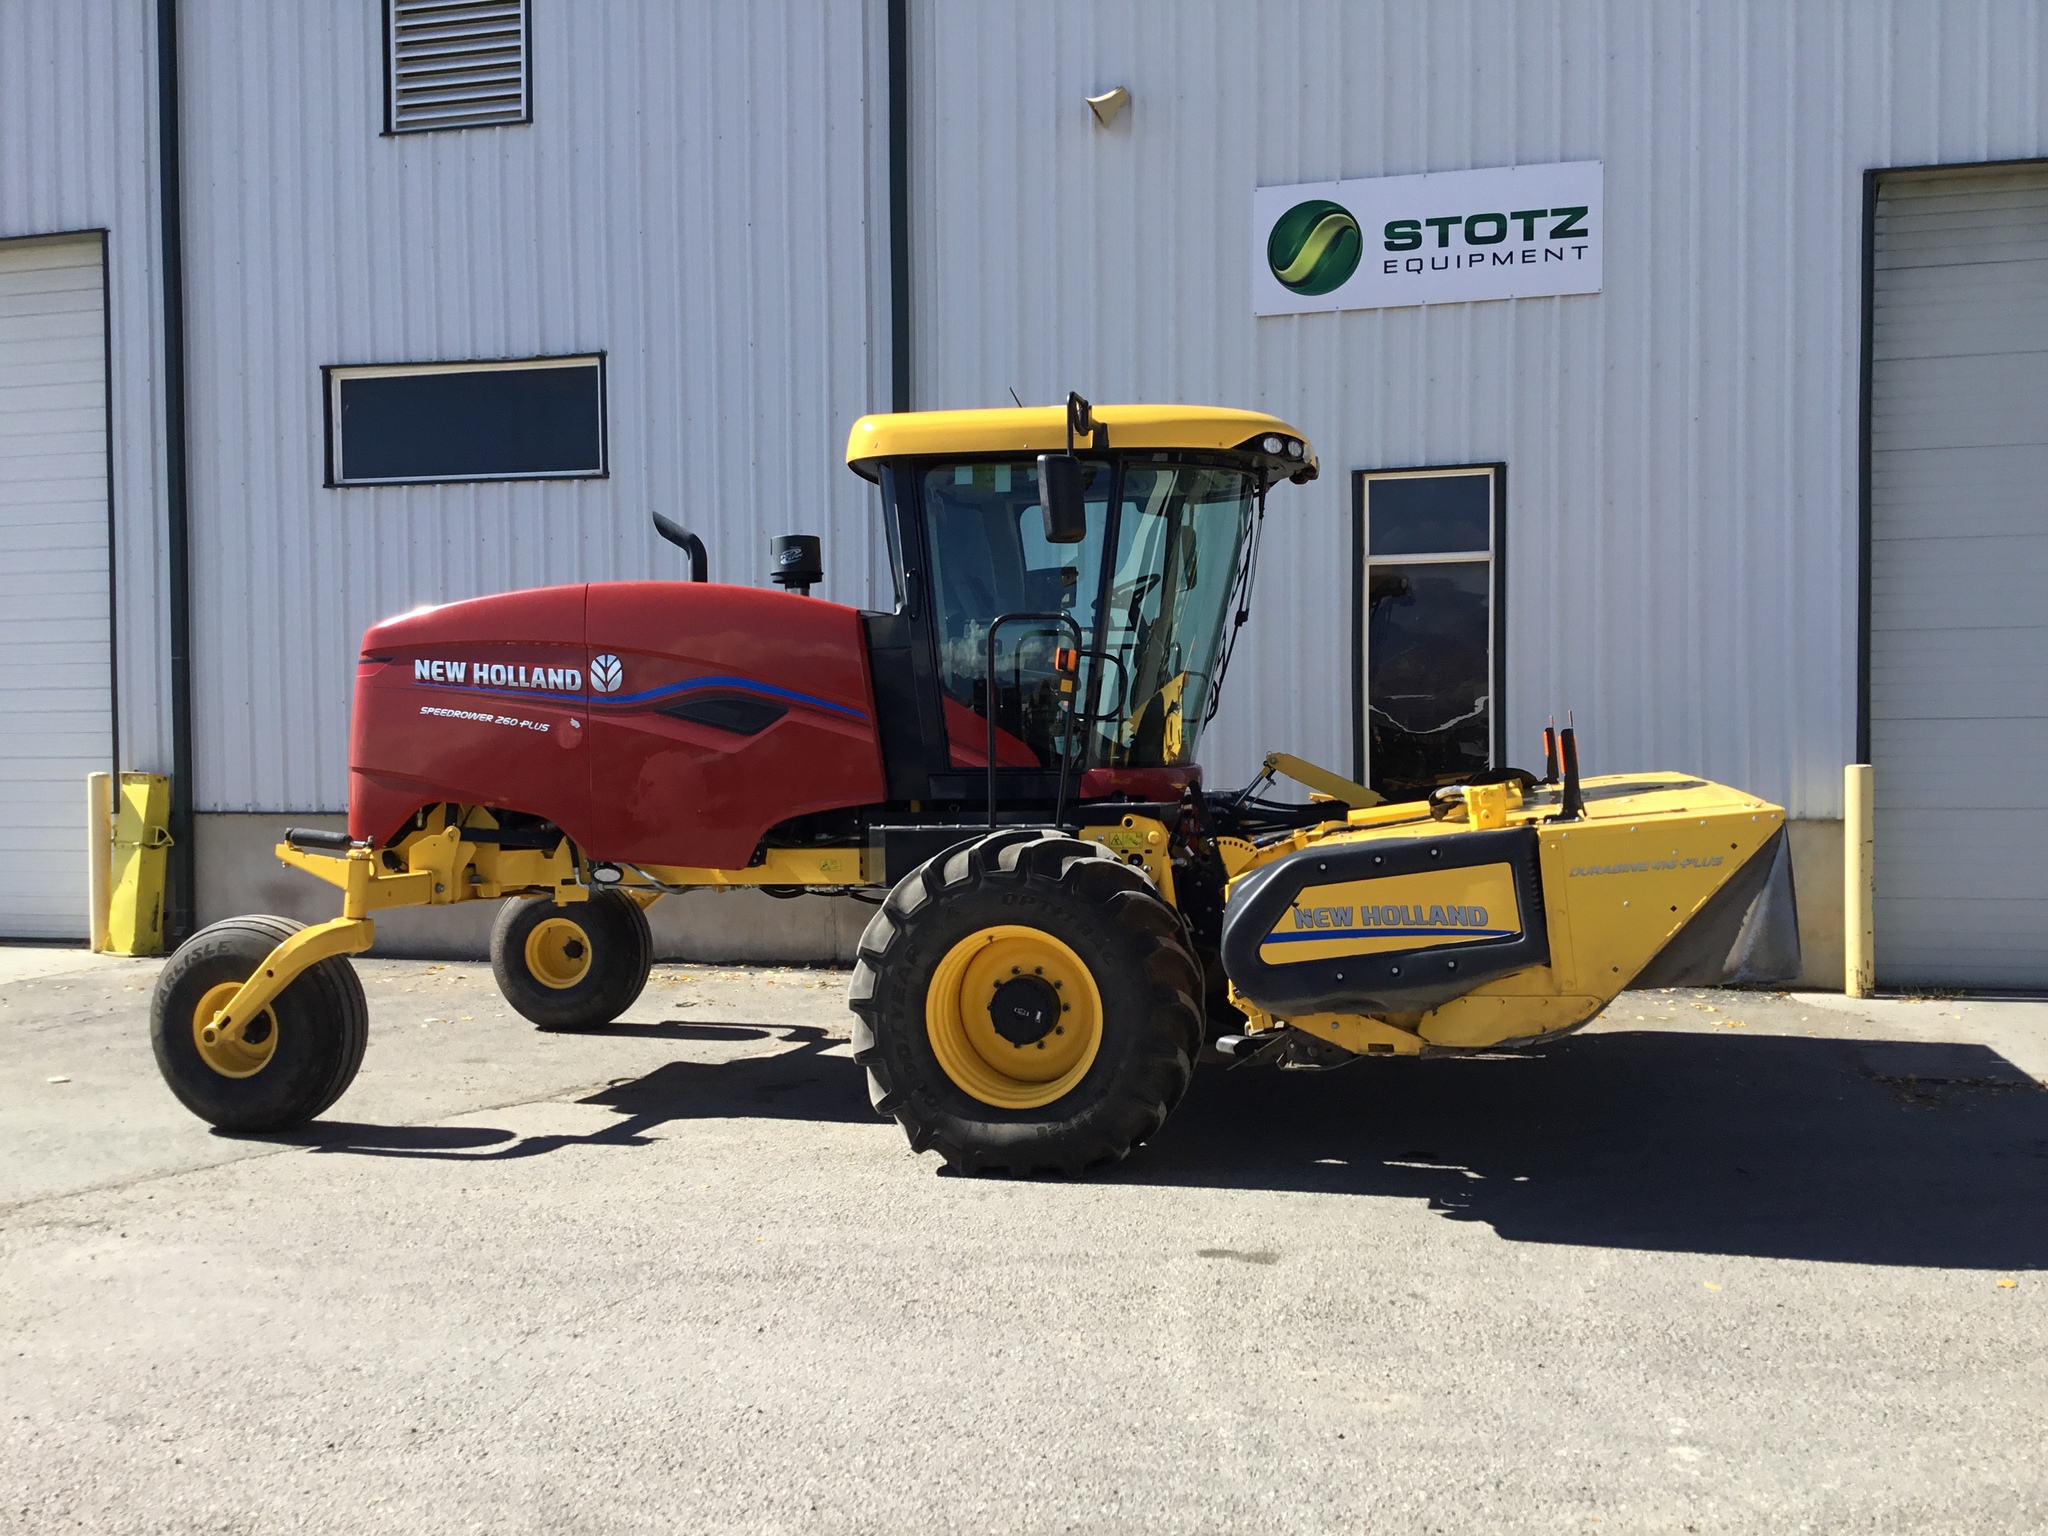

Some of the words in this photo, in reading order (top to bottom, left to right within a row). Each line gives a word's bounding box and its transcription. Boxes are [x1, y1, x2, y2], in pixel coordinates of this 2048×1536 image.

[1384, 206, 1588, 252] STOTZ
[1384, 245, 1589, 275] EQUIPMENT
[414, 659, 467, 682] NEW
[473, 663, 583, 691] HOLLAND
[420, 706, 494, 722] SPEEDROWER
[495, 715, 518, 727] 260
[1568, 861, 1650, 878] DURABINE
[1652, 858, 1678, 871] 416
[1293, 906, 1354, 928] NEW
[1361, 905, 1488, 927] HOLLAND
